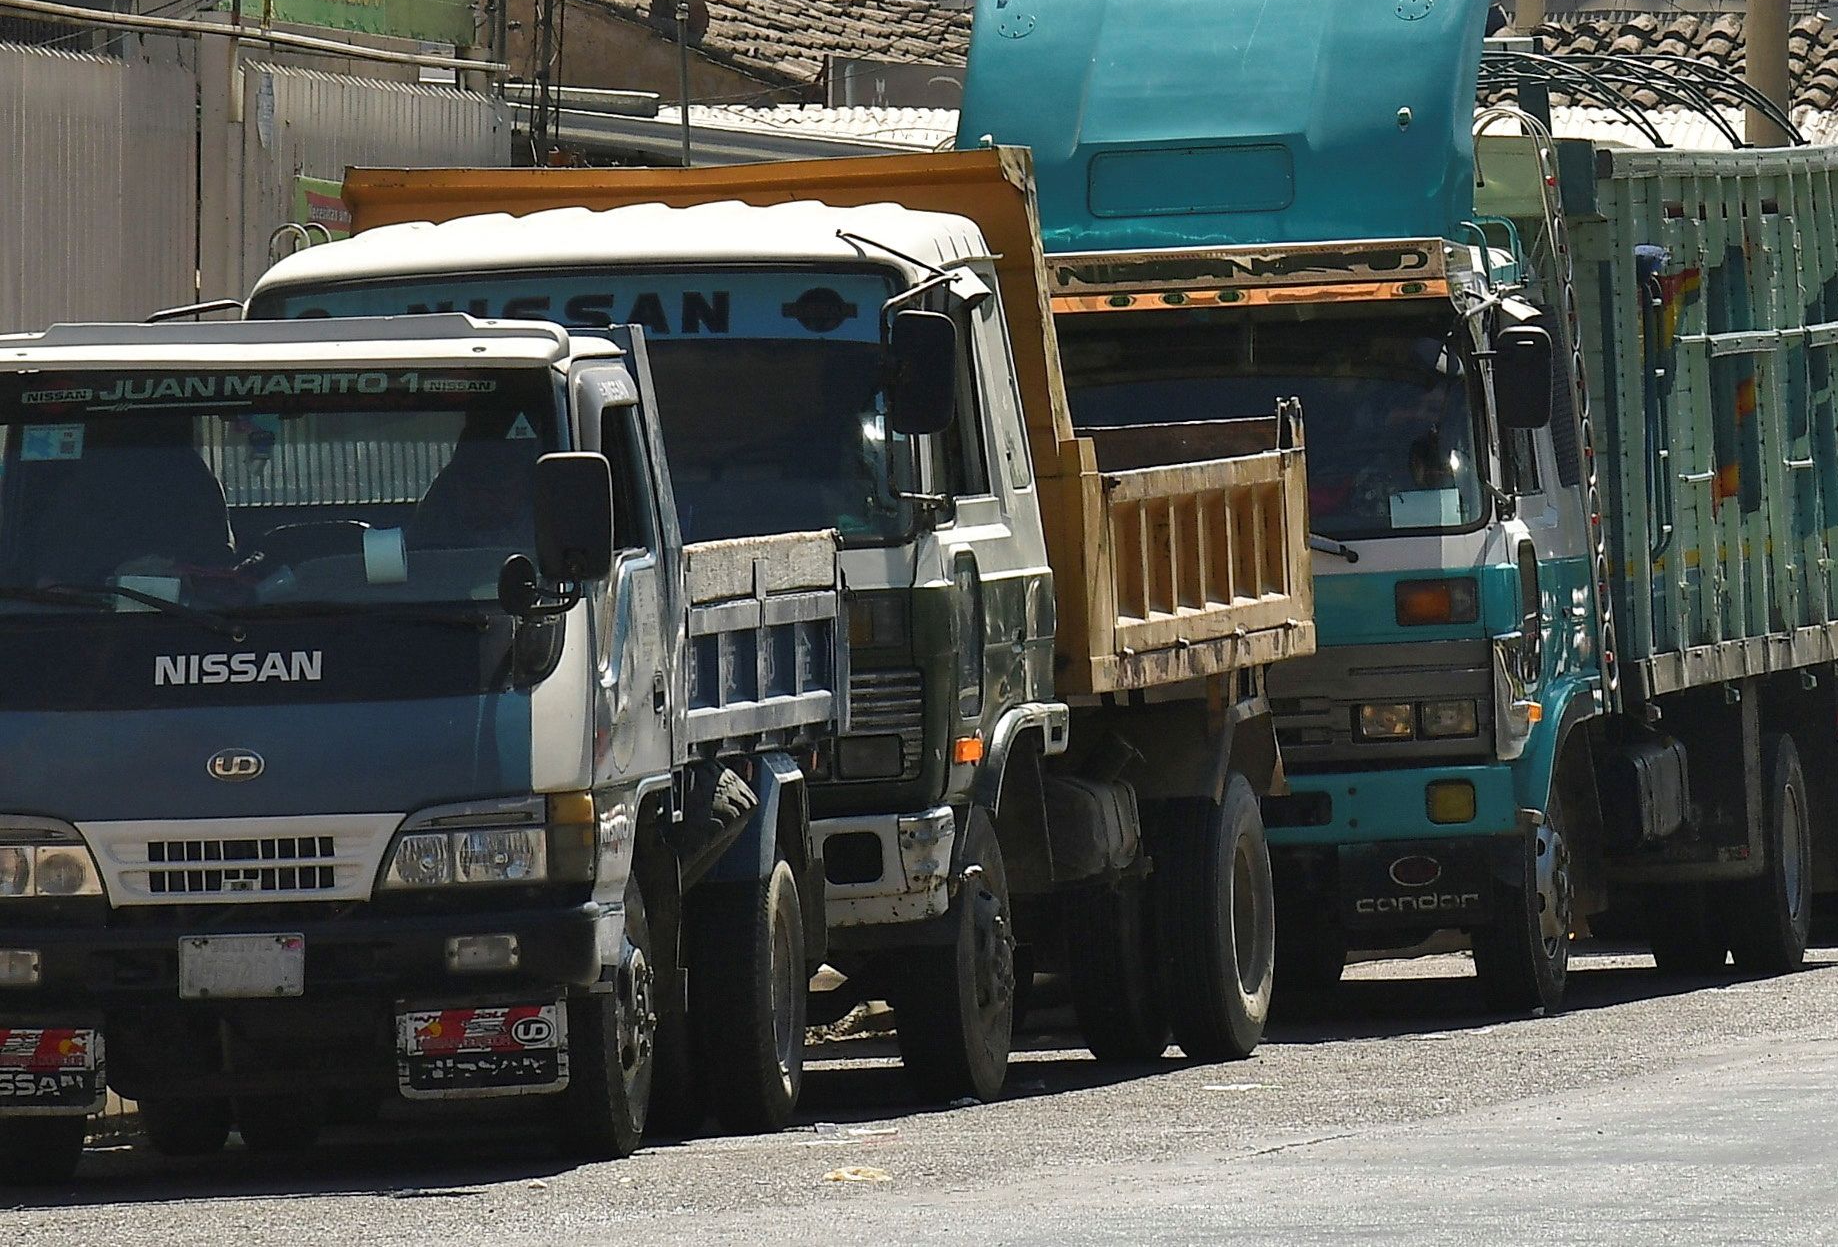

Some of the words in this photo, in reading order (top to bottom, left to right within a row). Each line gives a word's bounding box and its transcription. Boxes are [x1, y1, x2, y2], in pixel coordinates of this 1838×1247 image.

[407, 291, 731, 334] ISSAN
[27, 389, 88, 402] NISSAN
[100, 376, 217, 401] JUAN
[223, 372, 388, 398] MARITO
[430, 380, 492, 392] NISSAN
[154, 651, 323, 686] NISSAN
[215, 756, 258, 776] UD
[1356, 892, 1479, 914] condor
[517, 1022, 548, 1041] UD
